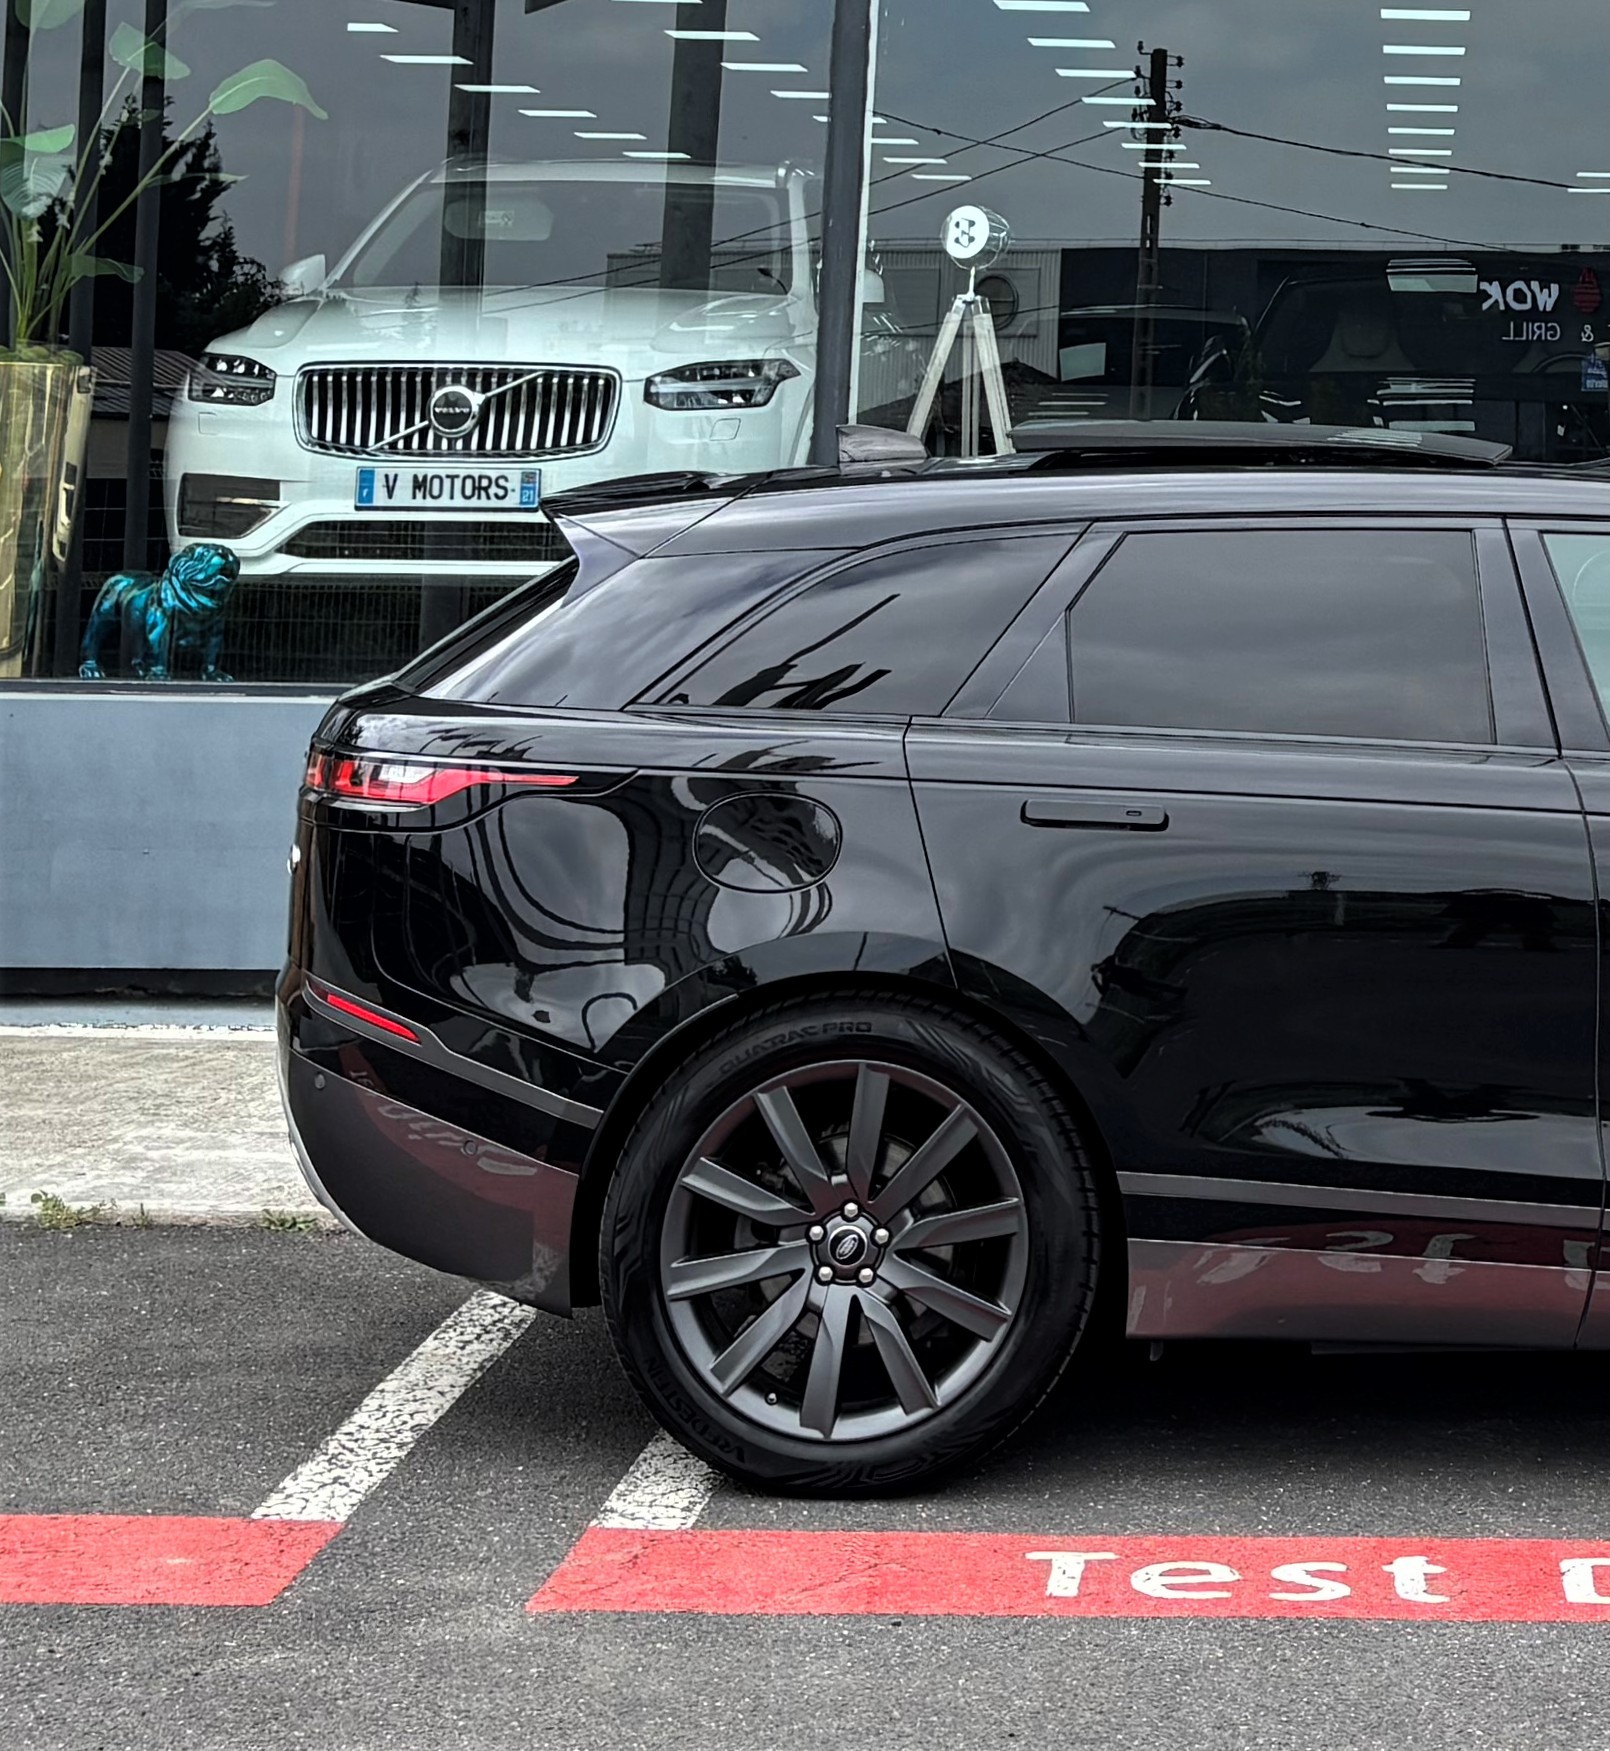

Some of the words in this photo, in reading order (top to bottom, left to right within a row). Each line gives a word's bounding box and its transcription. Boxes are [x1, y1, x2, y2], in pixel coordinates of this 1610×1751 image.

[384, 473, 398, 500] V
[412, 474, 509, 501] MOTORS
[718, 1025, 820, 1075] QUATRAC
[822, 1021, 873, 1035] PRO
[1024, 1551, 1452, 1604] Test
